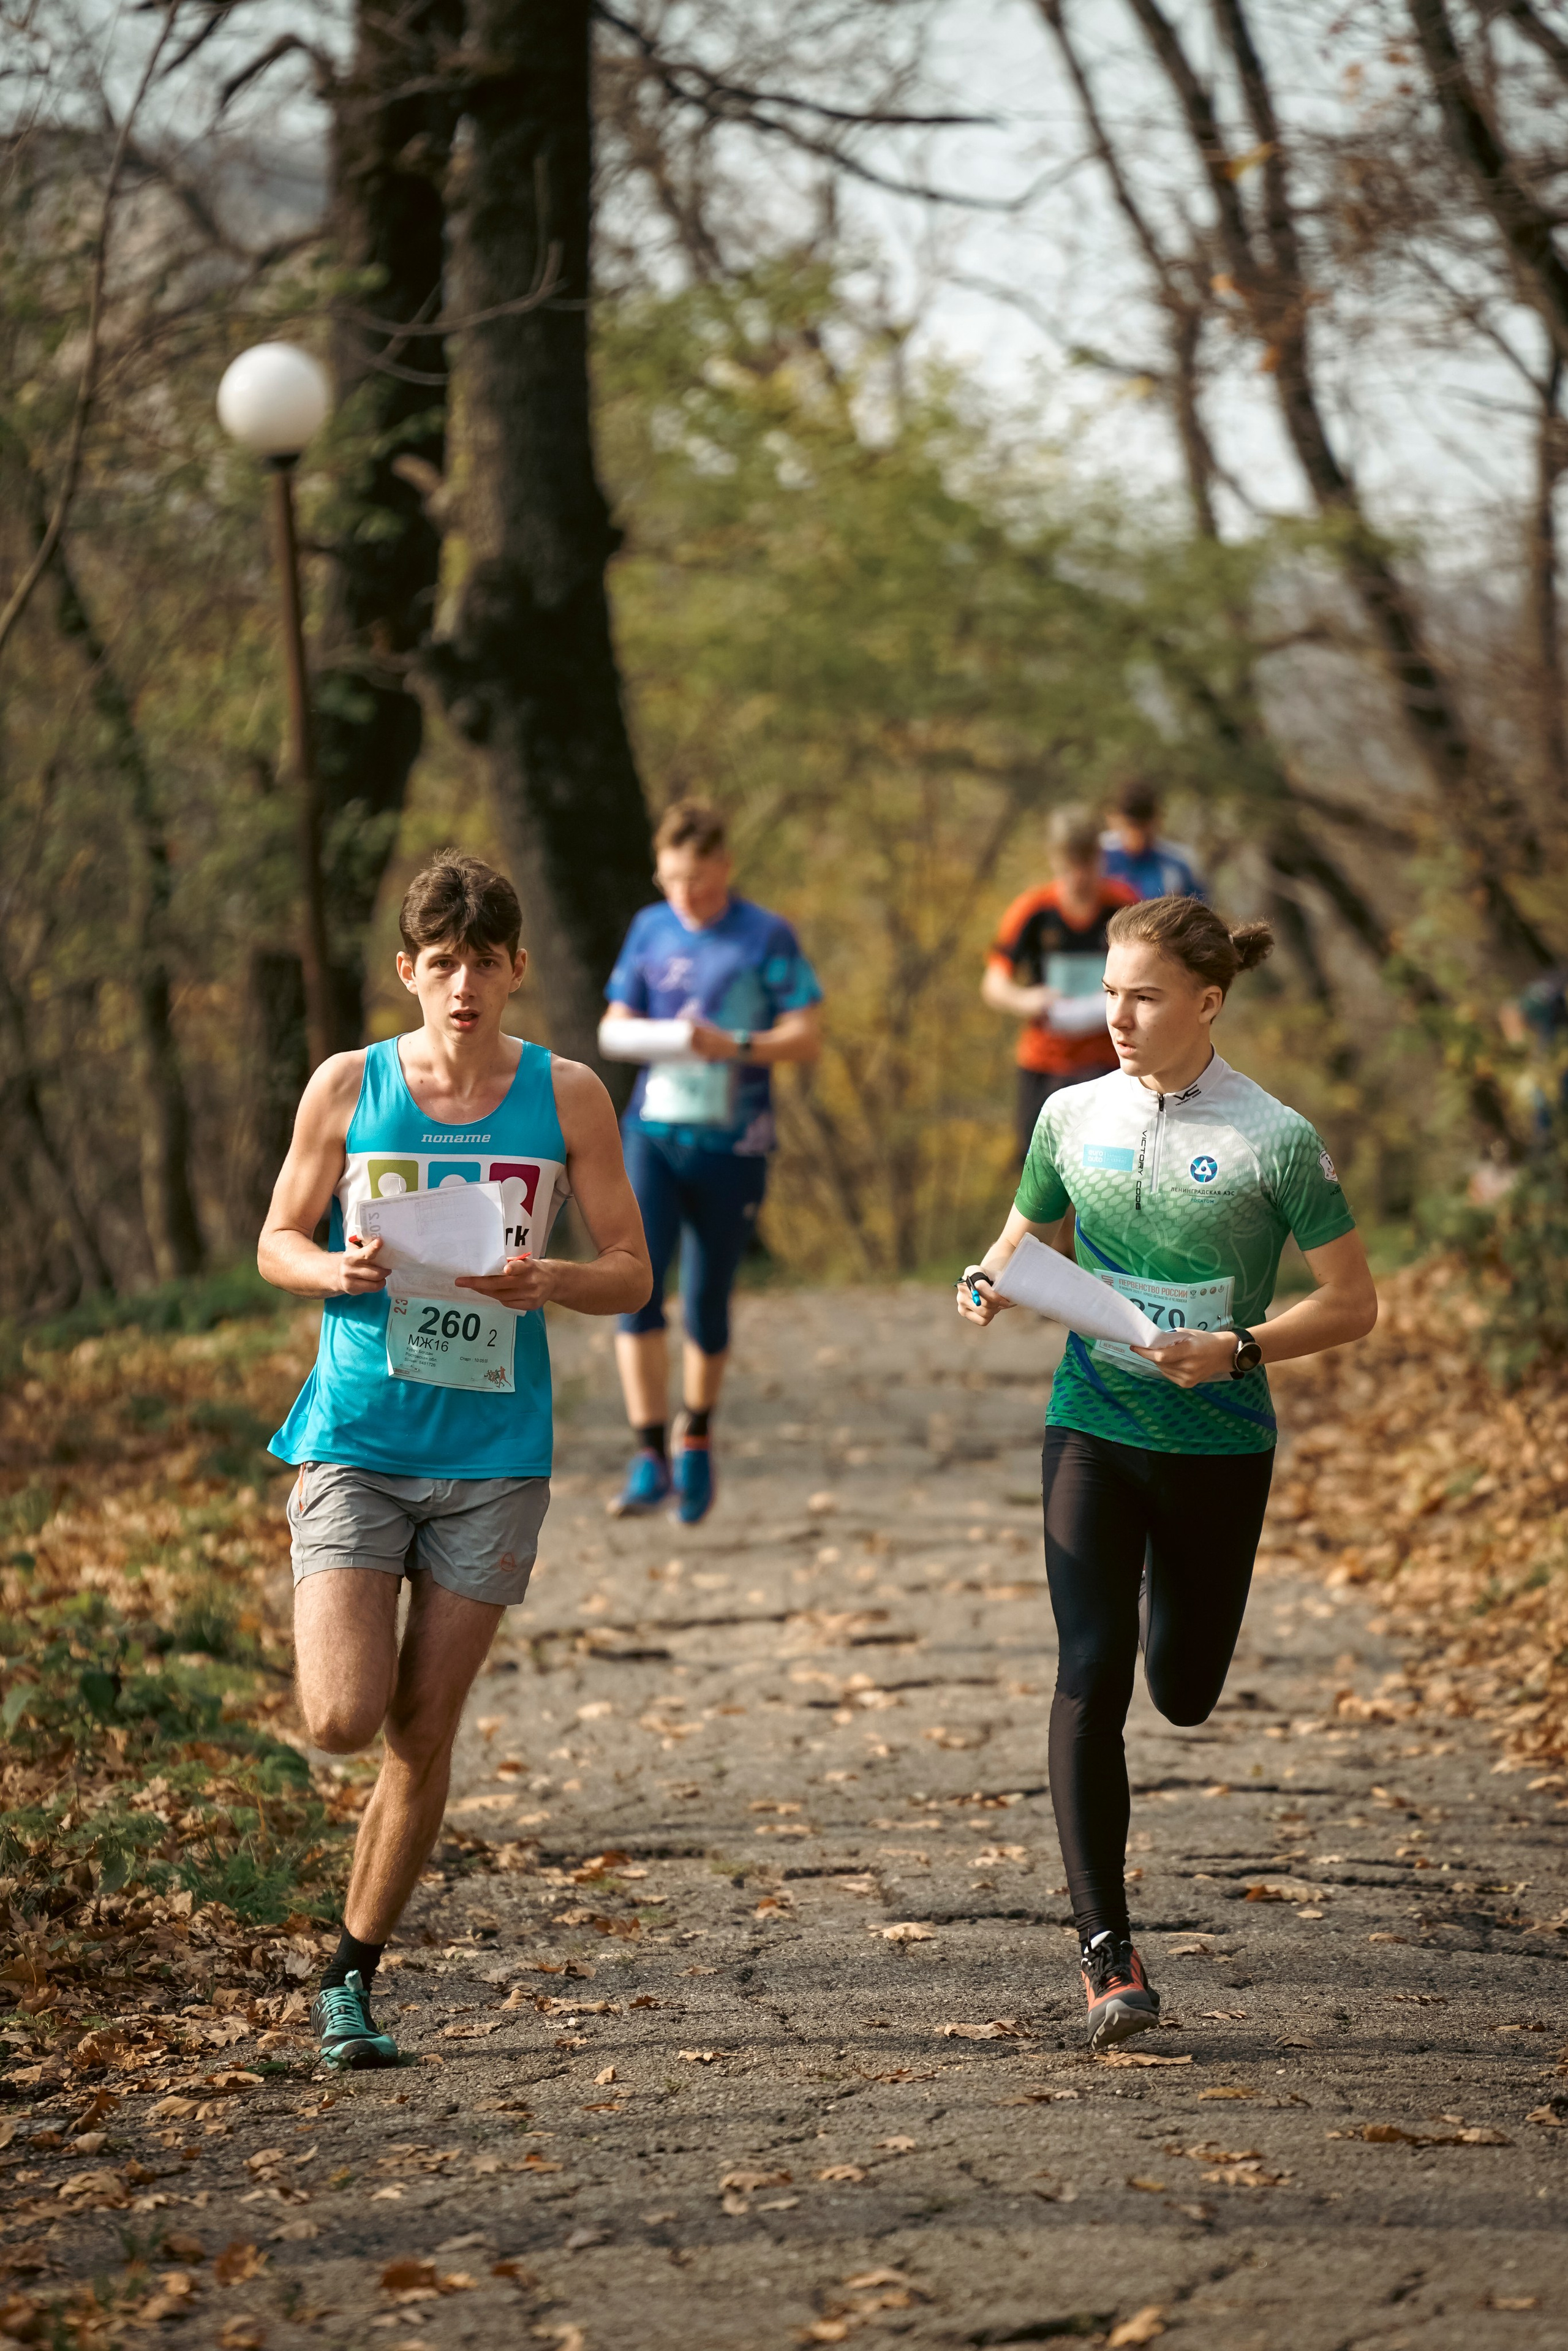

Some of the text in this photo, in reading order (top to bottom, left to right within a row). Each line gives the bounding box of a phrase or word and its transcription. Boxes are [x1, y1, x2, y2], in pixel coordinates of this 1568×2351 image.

[421, 1134, 491, 1143] noname
[1138, 1130, 1147, 1176] VICTORY
[1119, 1278, 1188, 1299] ПЕРВЕНСТВО РОССИИ
[418, 1306, 481, 1342] 260
[408, 1334, 449, 1352] МЖ16
[487, 1329, 497, 1347] 2
